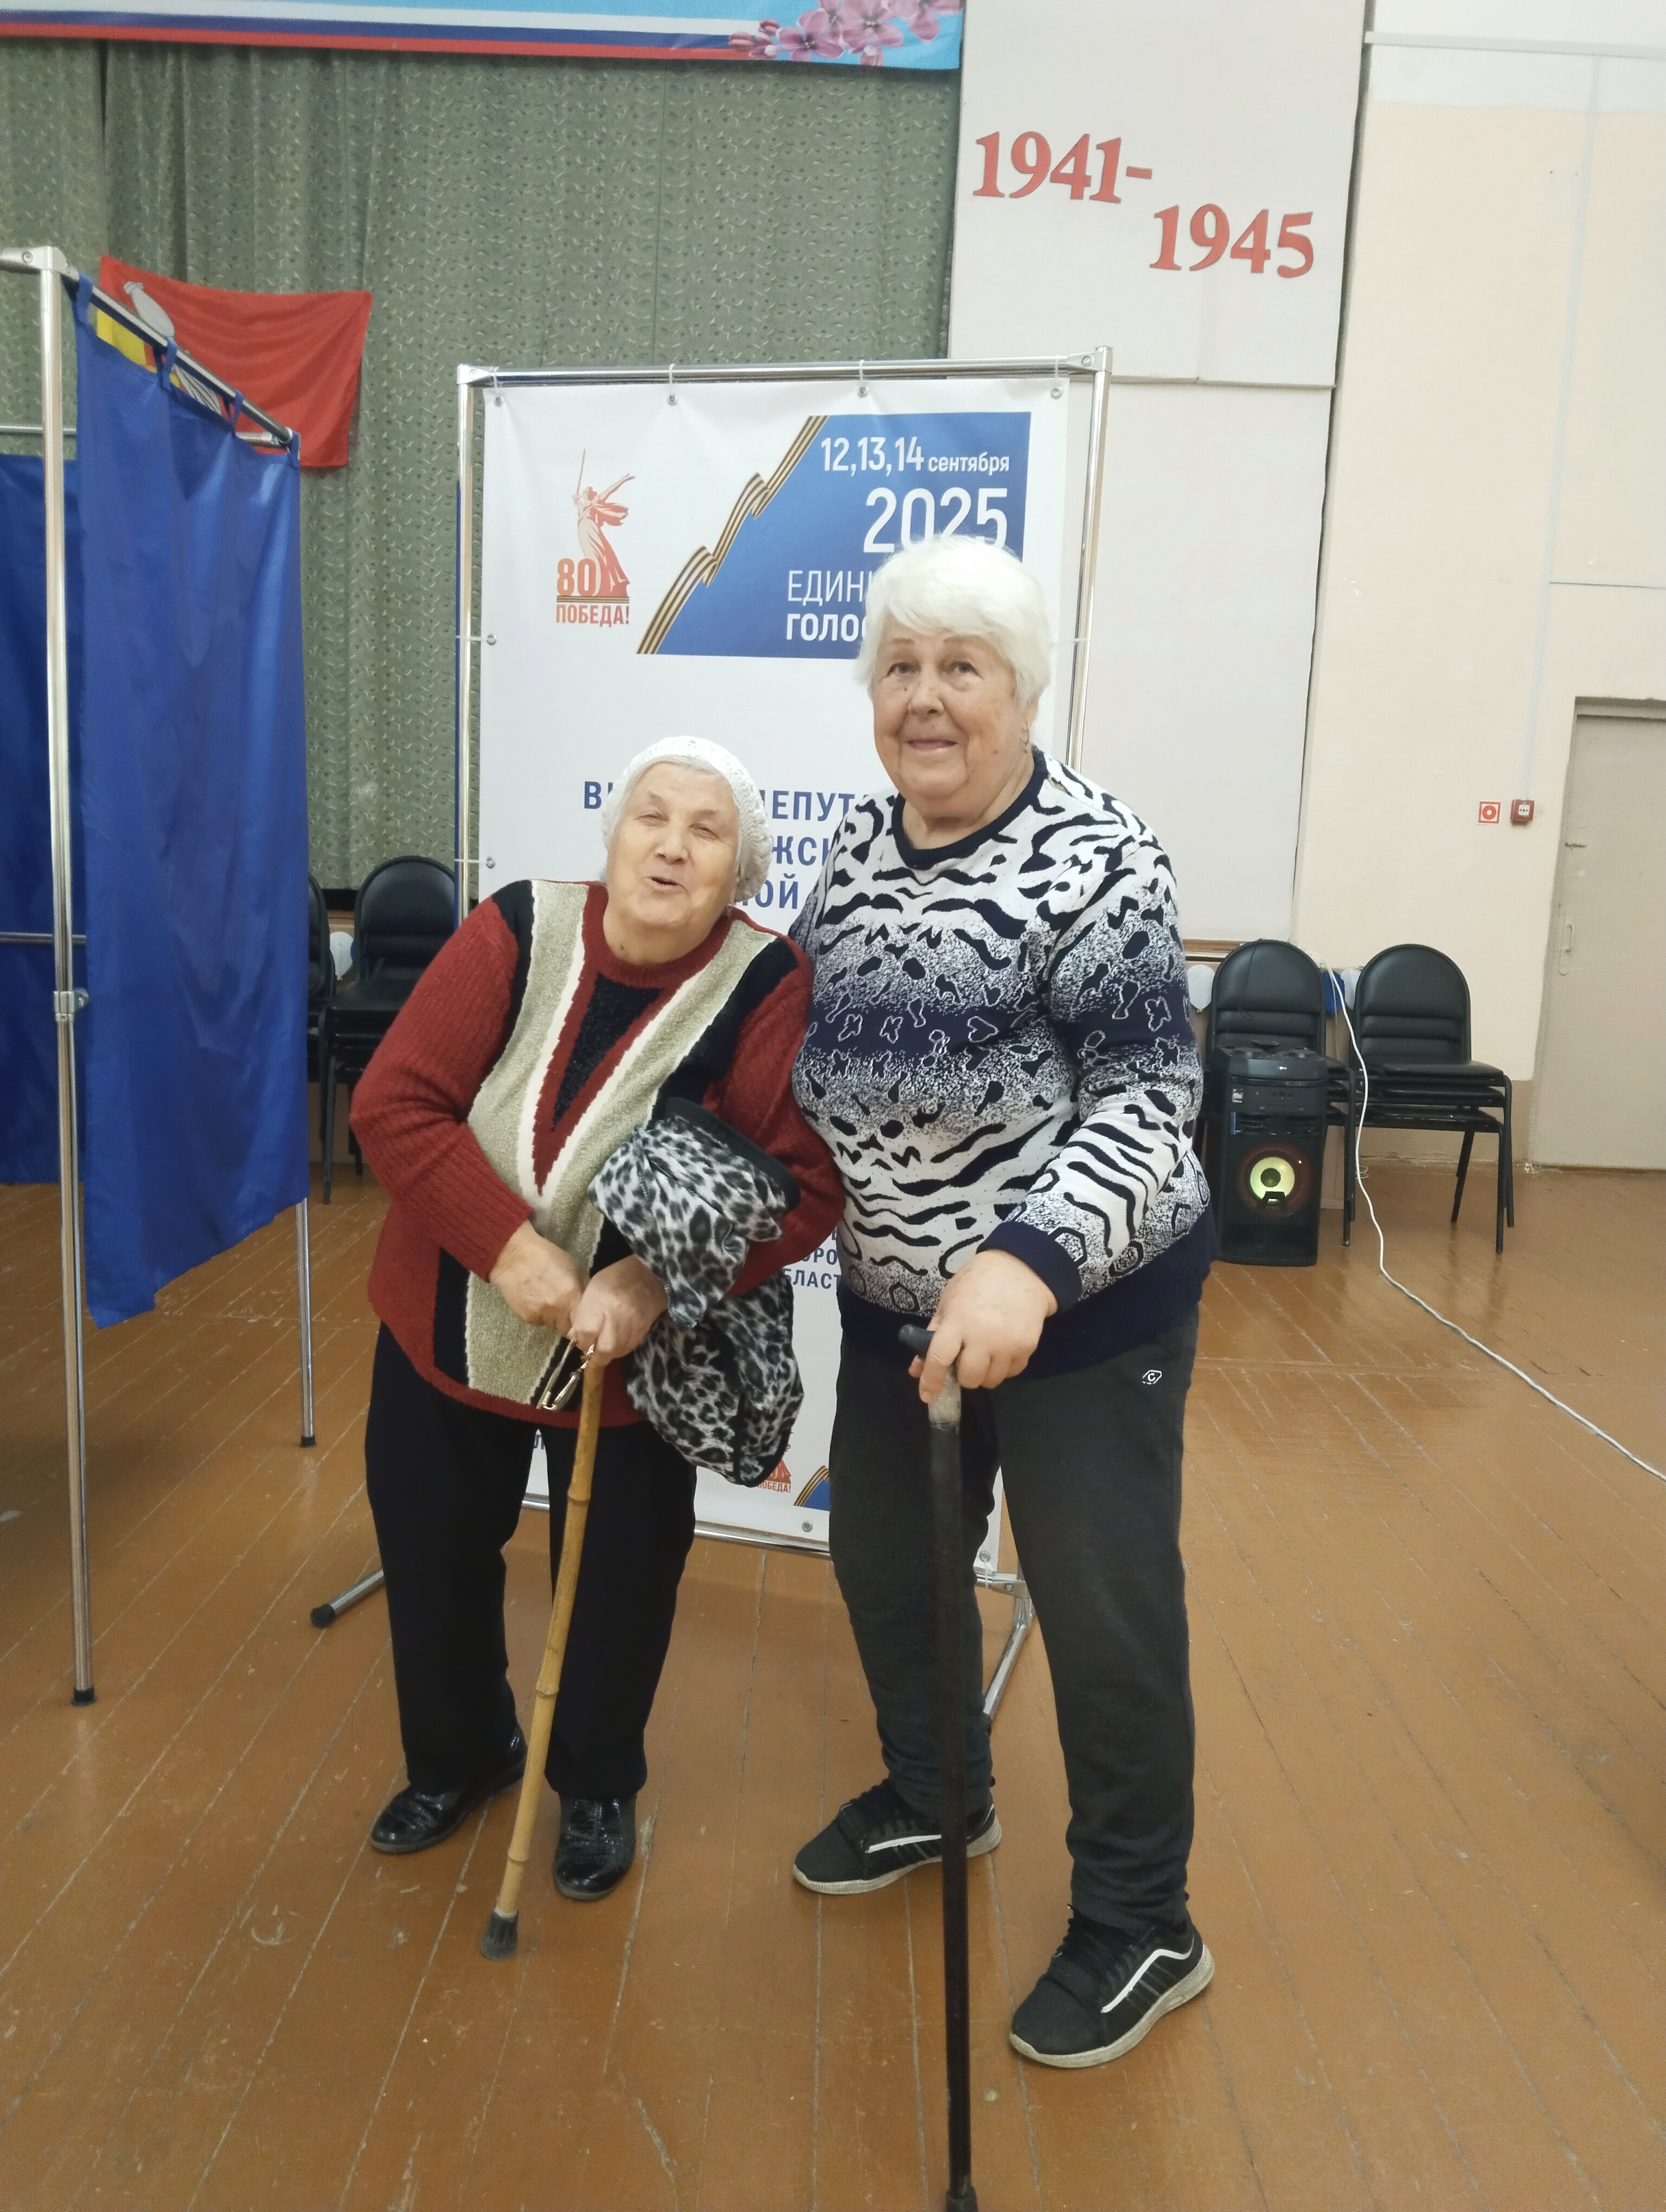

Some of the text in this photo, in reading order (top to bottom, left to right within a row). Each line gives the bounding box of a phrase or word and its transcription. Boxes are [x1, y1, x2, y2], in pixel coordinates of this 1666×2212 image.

[973, 131, 1152, 203] 1941-
[1150, 203, 1314, 278] 1945
[821, 436, 1010, 477] 12,13,14 сентября
[863, 487, 1008, 553] 2025
[556, 558, 597, 596] 80
[788, 570, 873, 607] ЕДИН
[556, 605, 630, 627] ПОБЕДА!
[759, 789, 870, 822] ЕПУТ
[741, 873, 798, 909] ОЙ
